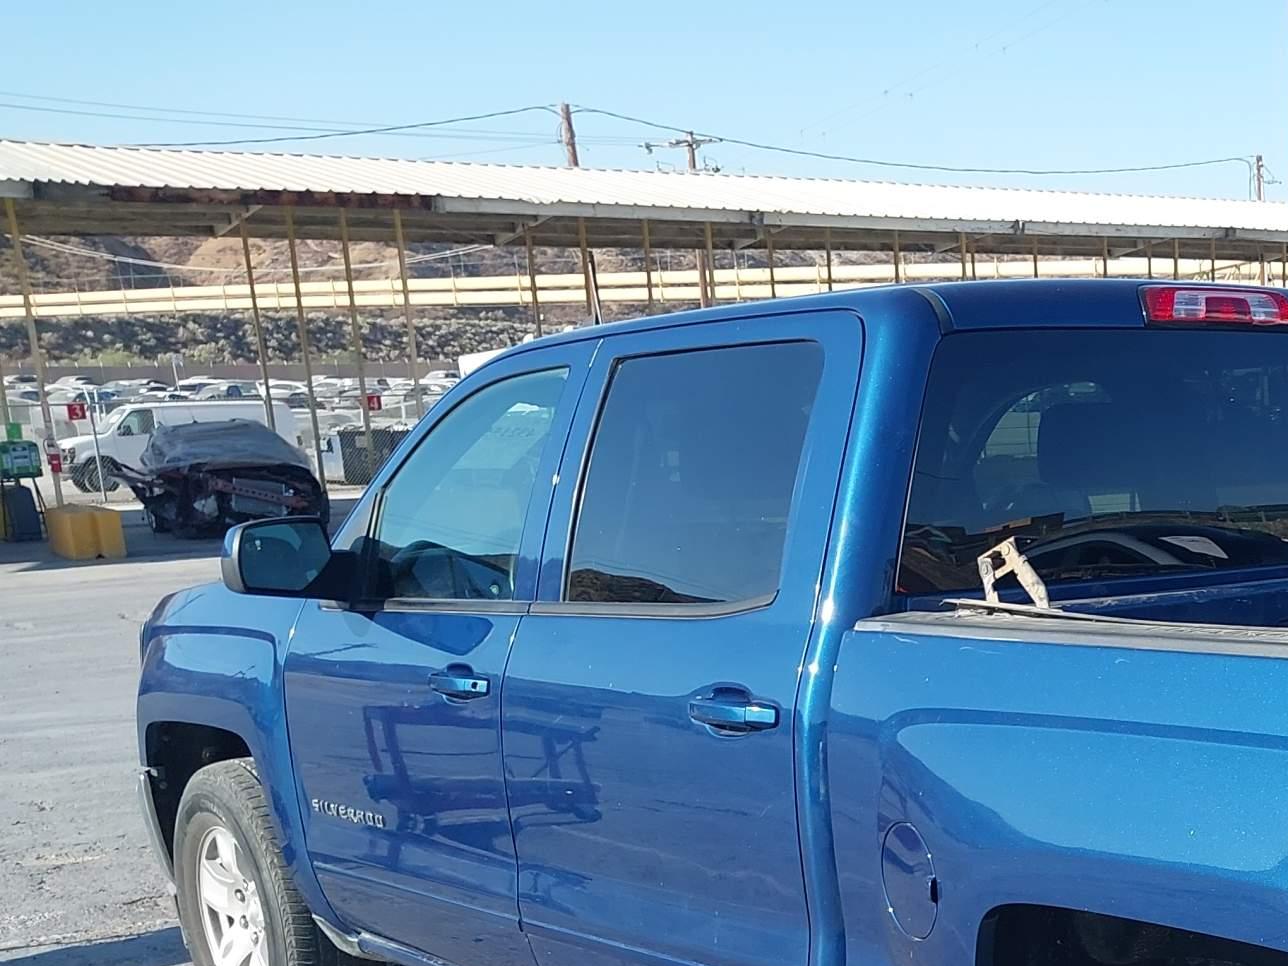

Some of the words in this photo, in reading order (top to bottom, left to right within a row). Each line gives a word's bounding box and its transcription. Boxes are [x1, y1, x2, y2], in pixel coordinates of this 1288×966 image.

[369, 396, 379, 410] 4
[71, 404, 82, 419] 3
[311, 799, 384, 828] SILVERADO
